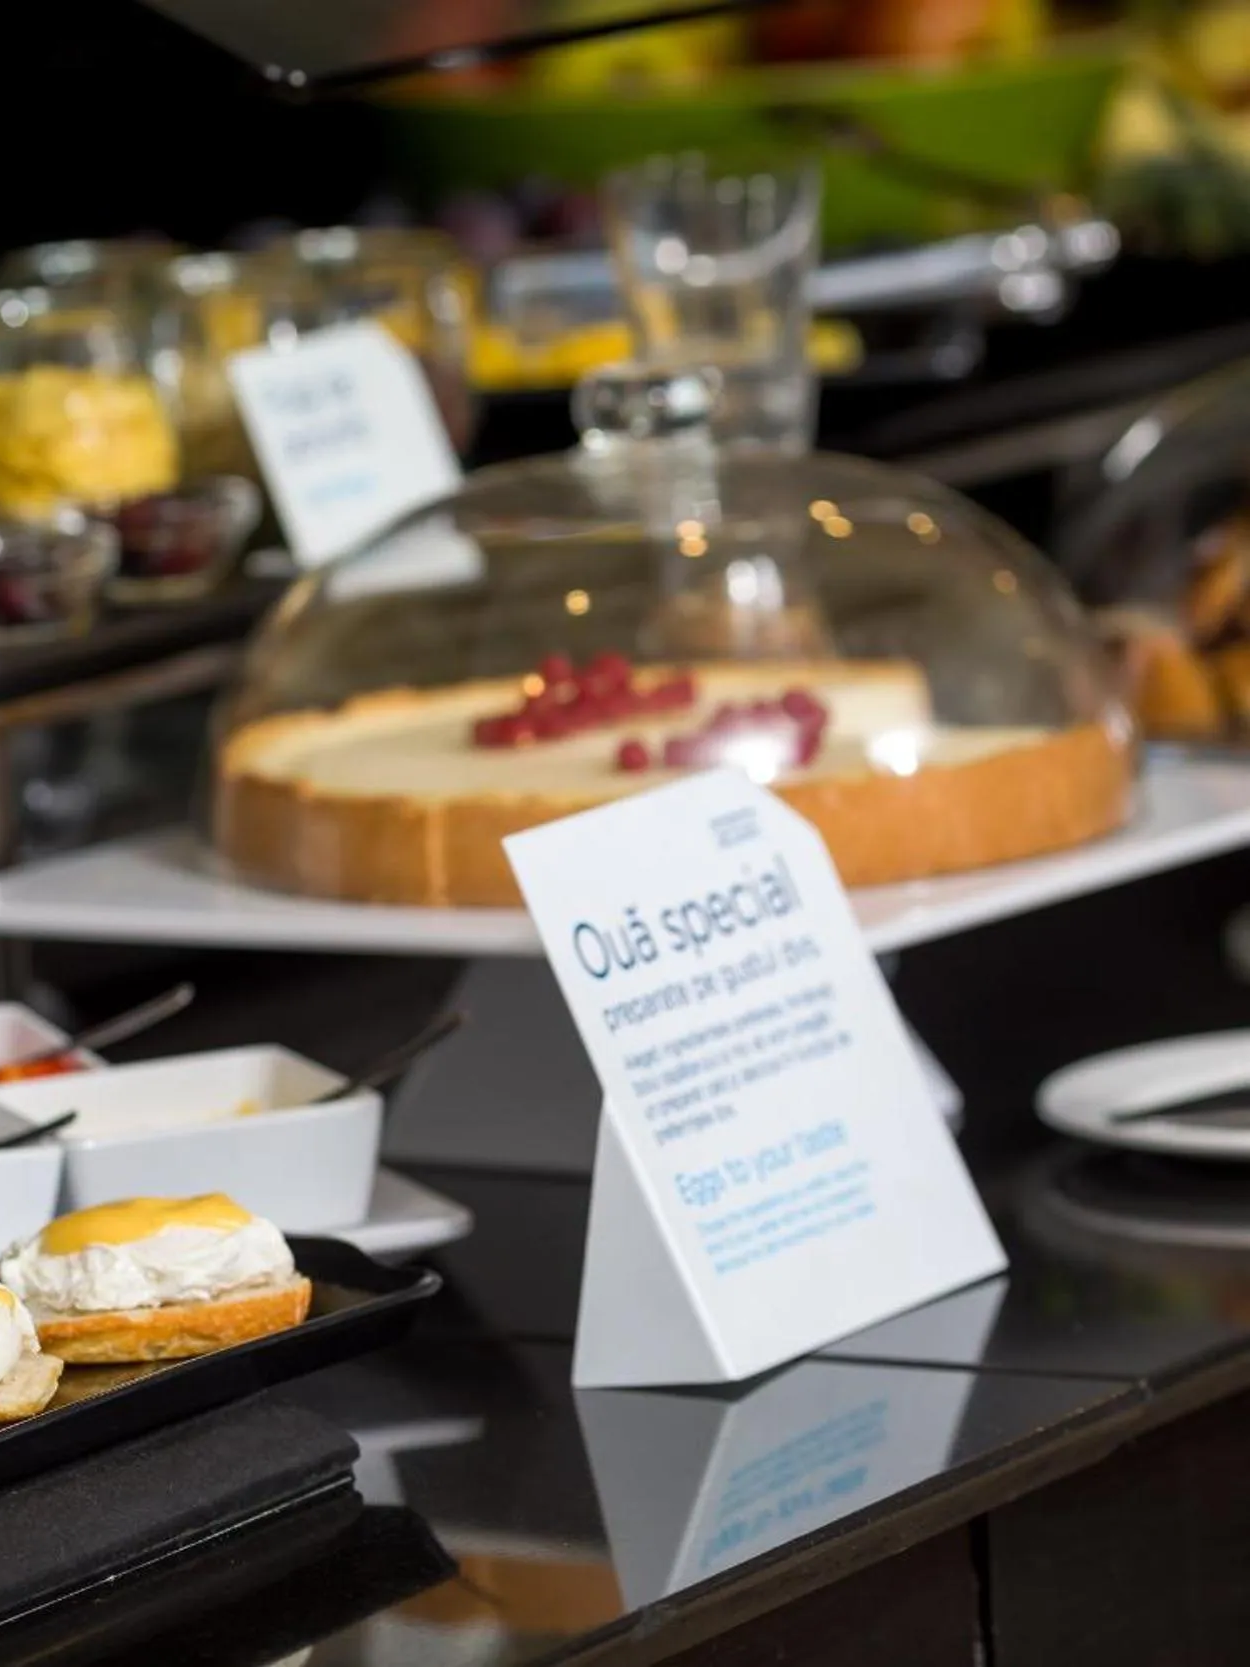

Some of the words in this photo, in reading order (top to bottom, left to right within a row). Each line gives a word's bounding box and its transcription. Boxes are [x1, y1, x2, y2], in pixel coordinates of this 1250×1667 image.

[573, 906, 658, 980] Ouă
[661, 853, 800, 957] special
[675, 1170, 726, 1206] Eggs
[723, 1157, 750, 1184] to
[754, 1143, 792, 1183] your
